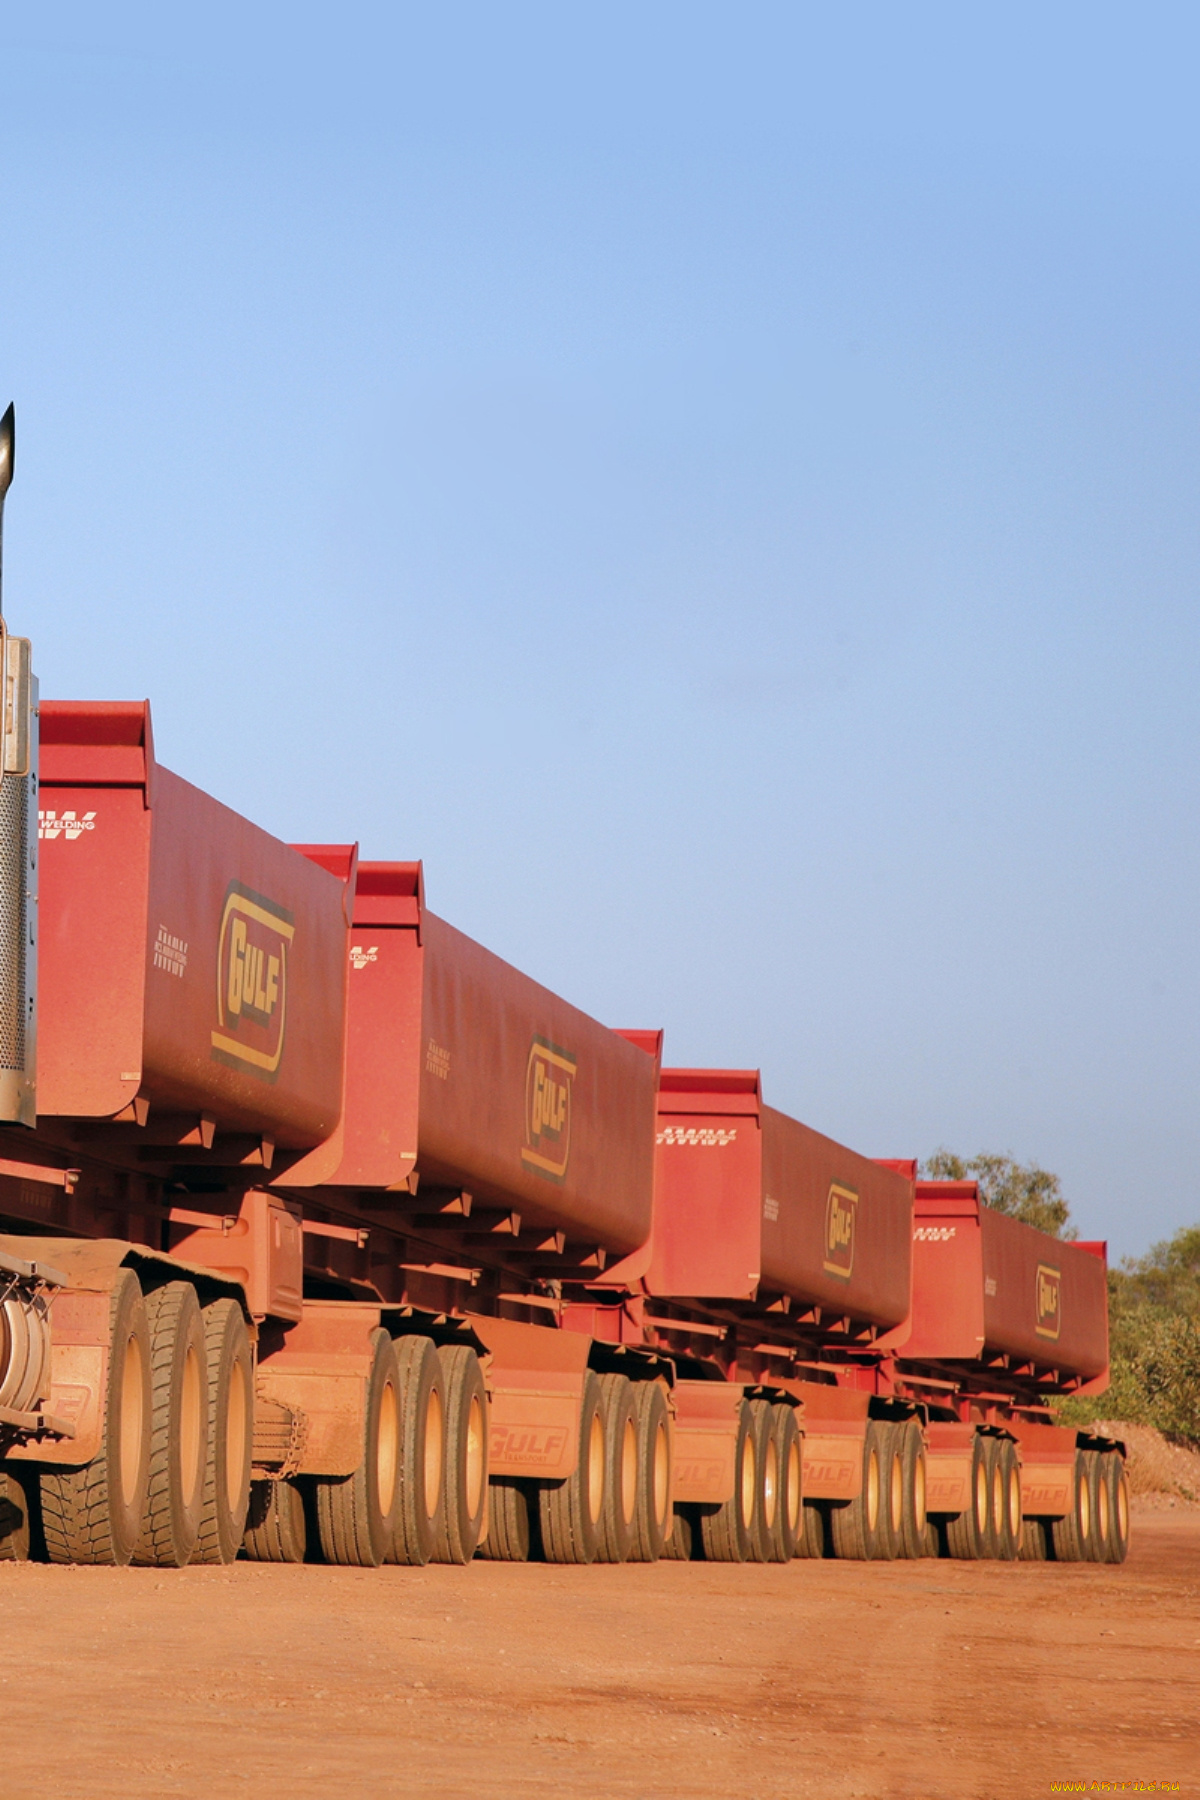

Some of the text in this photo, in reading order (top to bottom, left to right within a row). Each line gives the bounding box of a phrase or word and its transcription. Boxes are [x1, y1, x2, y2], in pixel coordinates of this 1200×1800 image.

[41, 820, 96, 830] WELDING
[227, 917, 280, 1015] GULF
[531, 1060, 566, 1135] GULF
